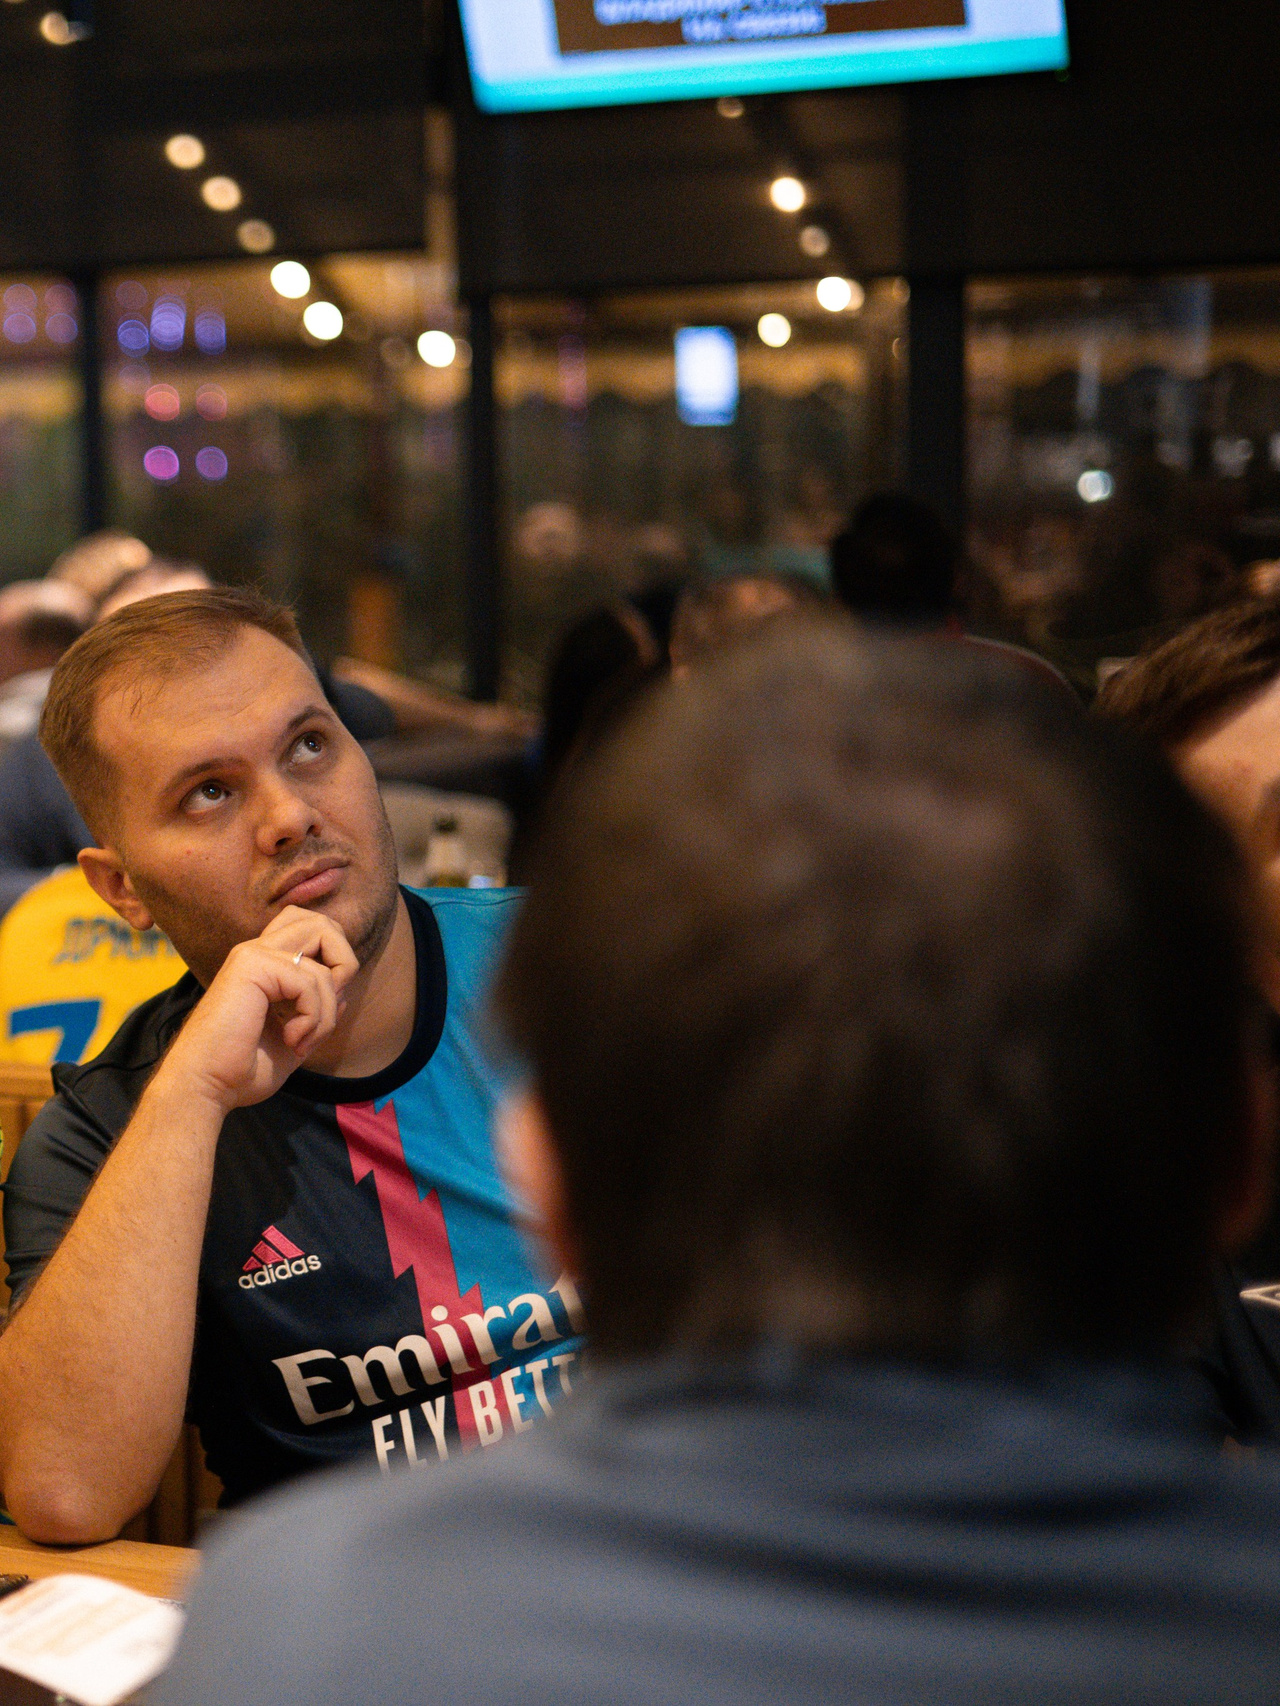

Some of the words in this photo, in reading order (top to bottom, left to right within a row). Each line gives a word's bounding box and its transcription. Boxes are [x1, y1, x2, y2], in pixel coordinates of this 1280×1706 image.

[10, 999, 101, 1063] 7
[238, 1254, 322, 1289] adidas
[271, 1273, 586, 1426] Emirat
[371, 1395, 450, 1474] FLY
[468, 1352, 577, 1447] BETT
